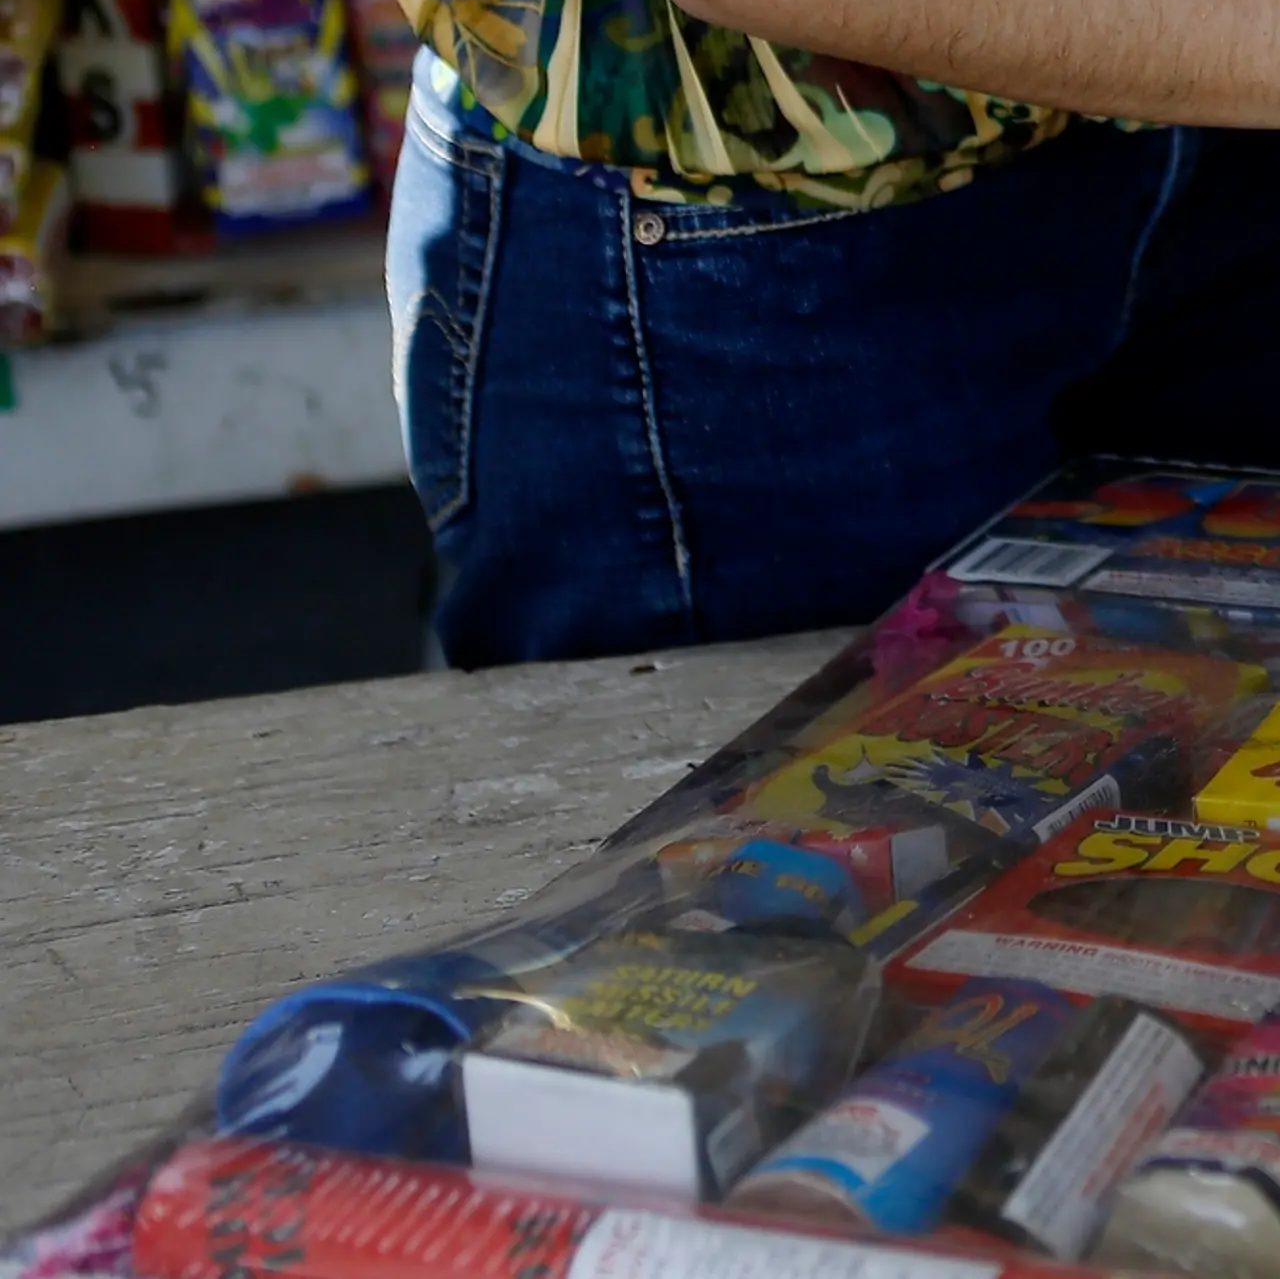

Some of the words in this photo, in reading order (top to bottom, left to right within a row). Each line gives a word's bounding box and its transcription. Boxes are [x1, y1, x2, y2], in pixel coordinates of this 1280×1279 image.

[1000, 638, 1077, 659] 100
[1093, 813, 1260, 843] JUMP
[995, 935, 1098, 958] WARNING
